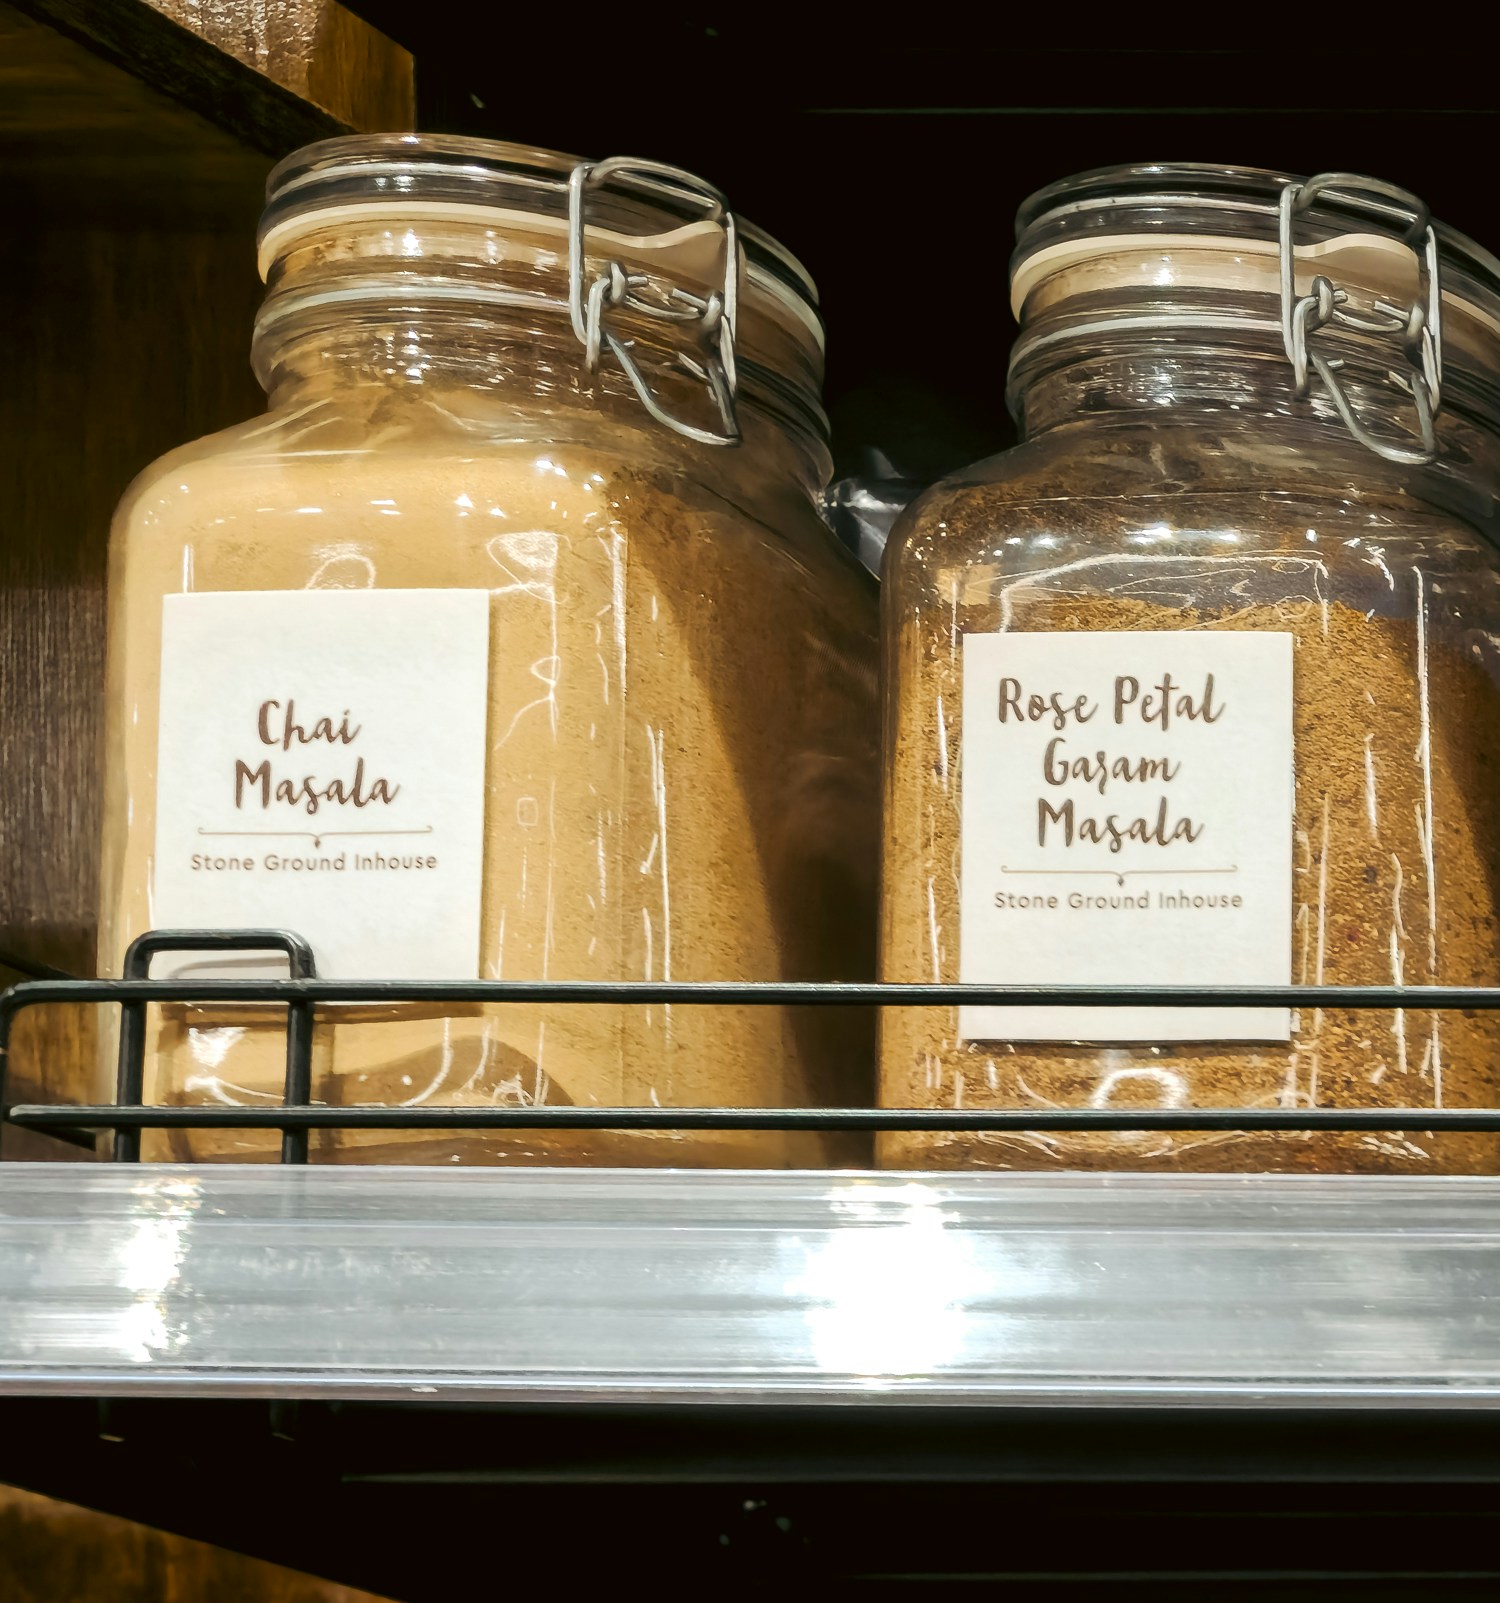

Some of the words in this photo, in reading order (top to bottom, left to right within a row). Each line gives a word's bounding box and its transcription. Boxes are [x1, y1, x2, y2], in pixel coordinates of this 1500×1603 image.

[257, 699, 361, 751] Chai
[998, 678, 1098, 731] Rose
[1114, 673, 1226, 732] Petal
[234, 757, 401, 815] Masala
[1044, 737, 1181, 795] Garam
[1038, 796, 1204, 853] Masala
[190, 854, 255, 871] Stone
[263, 852, 346, 872] Ground
[355, 852, 438, 871] Inhouse
[994, 892, 1059, 910] Stone
[1067, 890, 1150, 910] Ground
[1159, 889, 1243, 909] Inhouse
